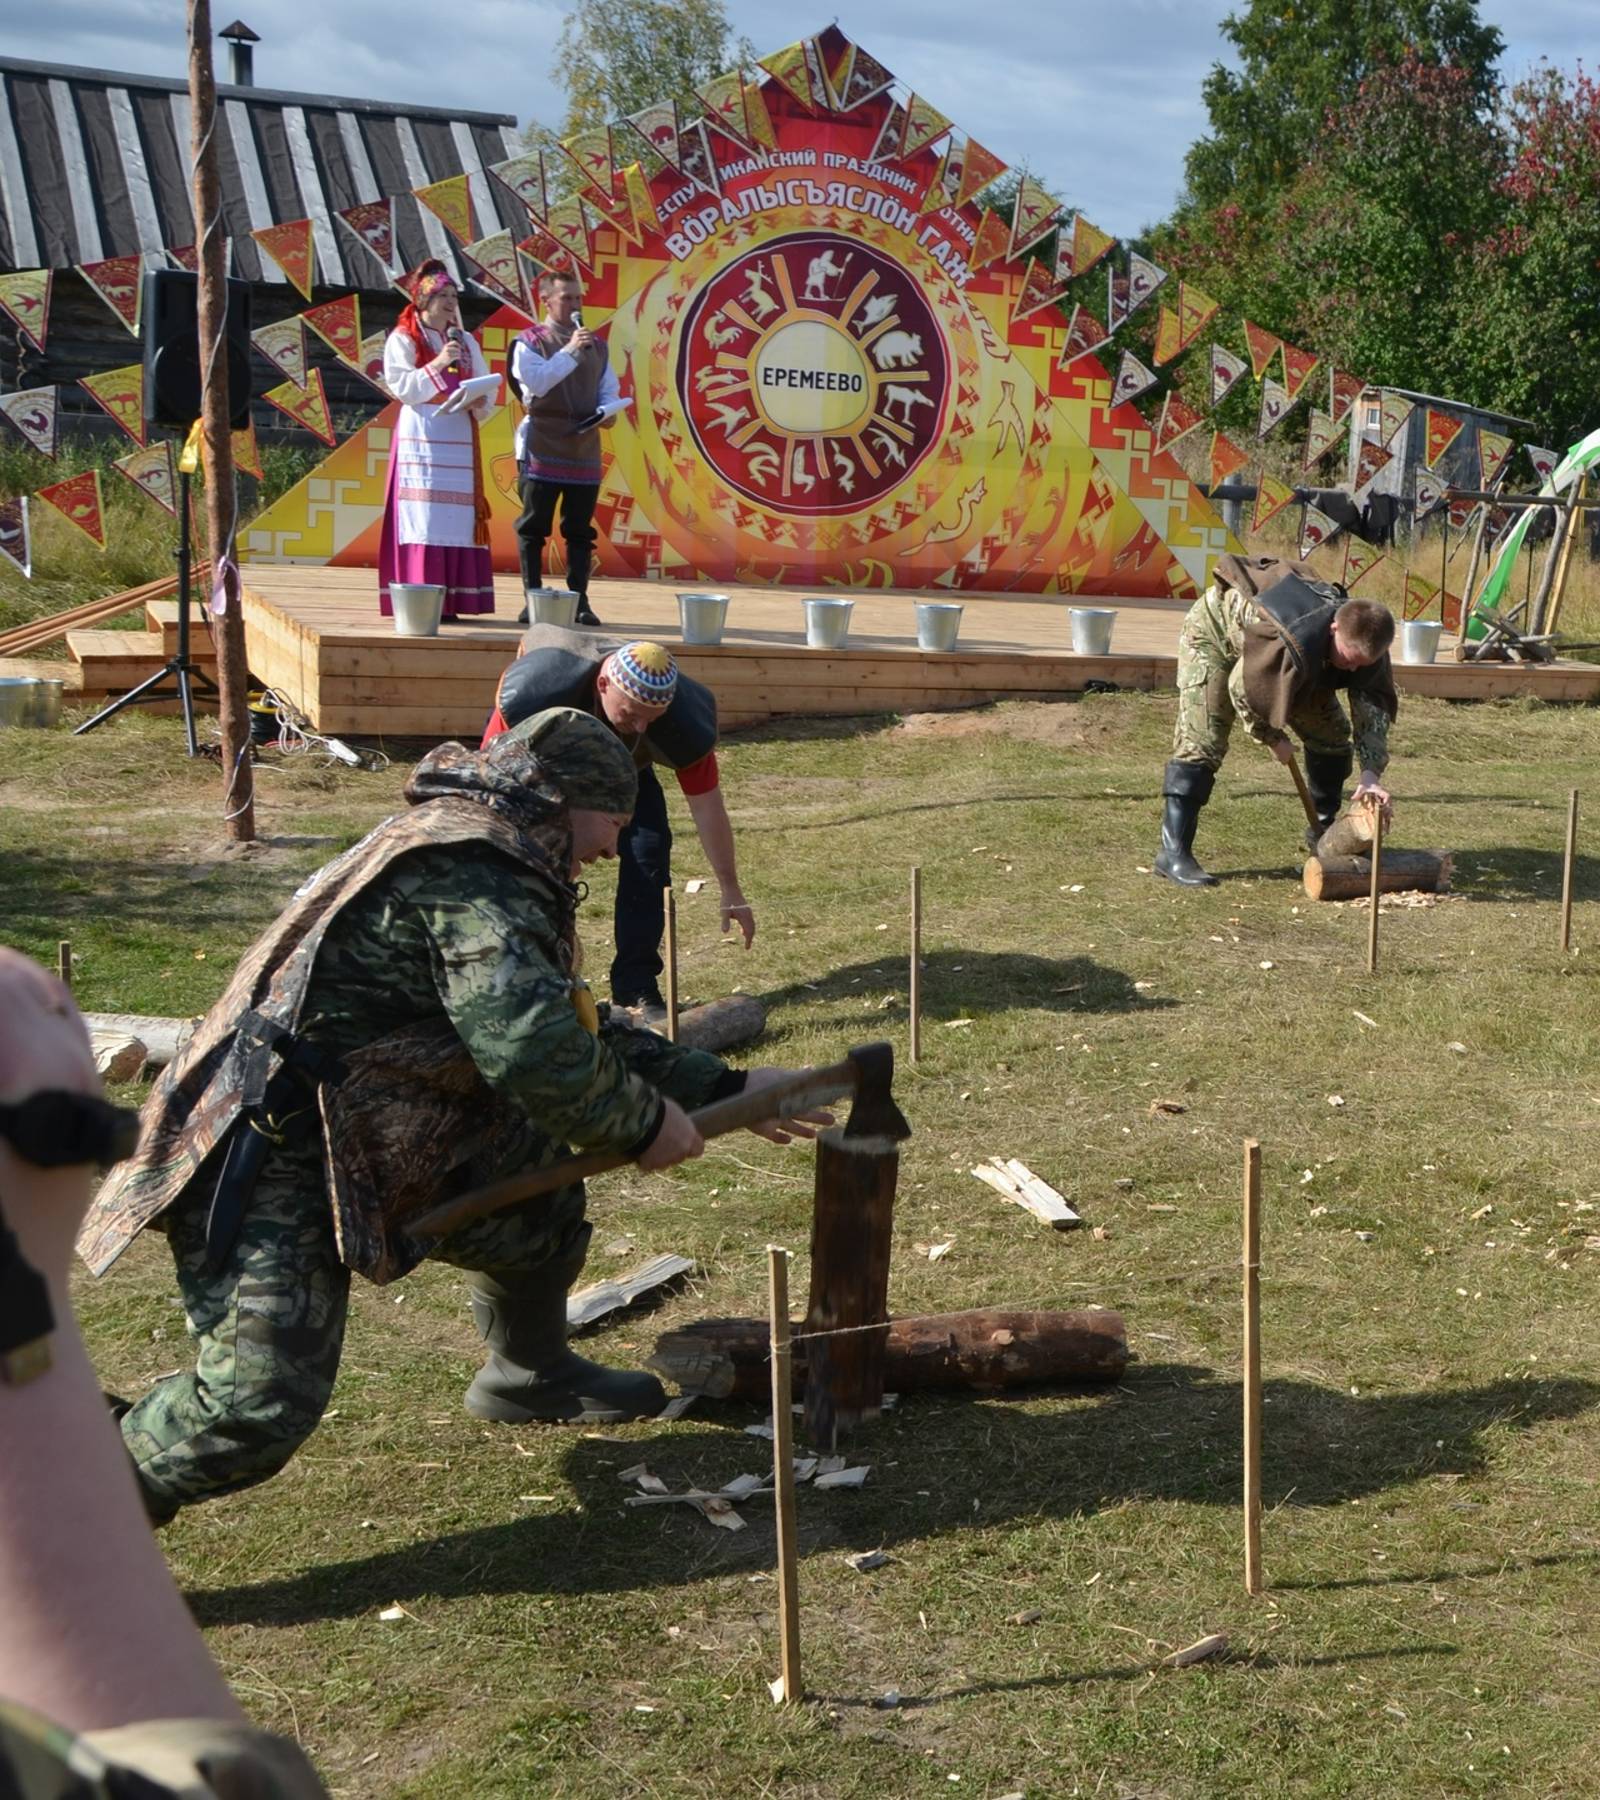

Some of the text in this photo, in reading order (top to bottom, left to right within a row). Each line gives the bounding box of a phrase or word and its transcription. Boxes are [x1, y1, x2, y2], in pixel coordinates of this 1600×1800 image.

[655, 148, 817, 224] ЕСПУИКАНСКИЙ
[823, 151, 919, 196] ПРАЗДНИК
[917, 224, 977, 289] ГАЖ
[763, 367, 862, 393] ЕРЕМЕЕВО
